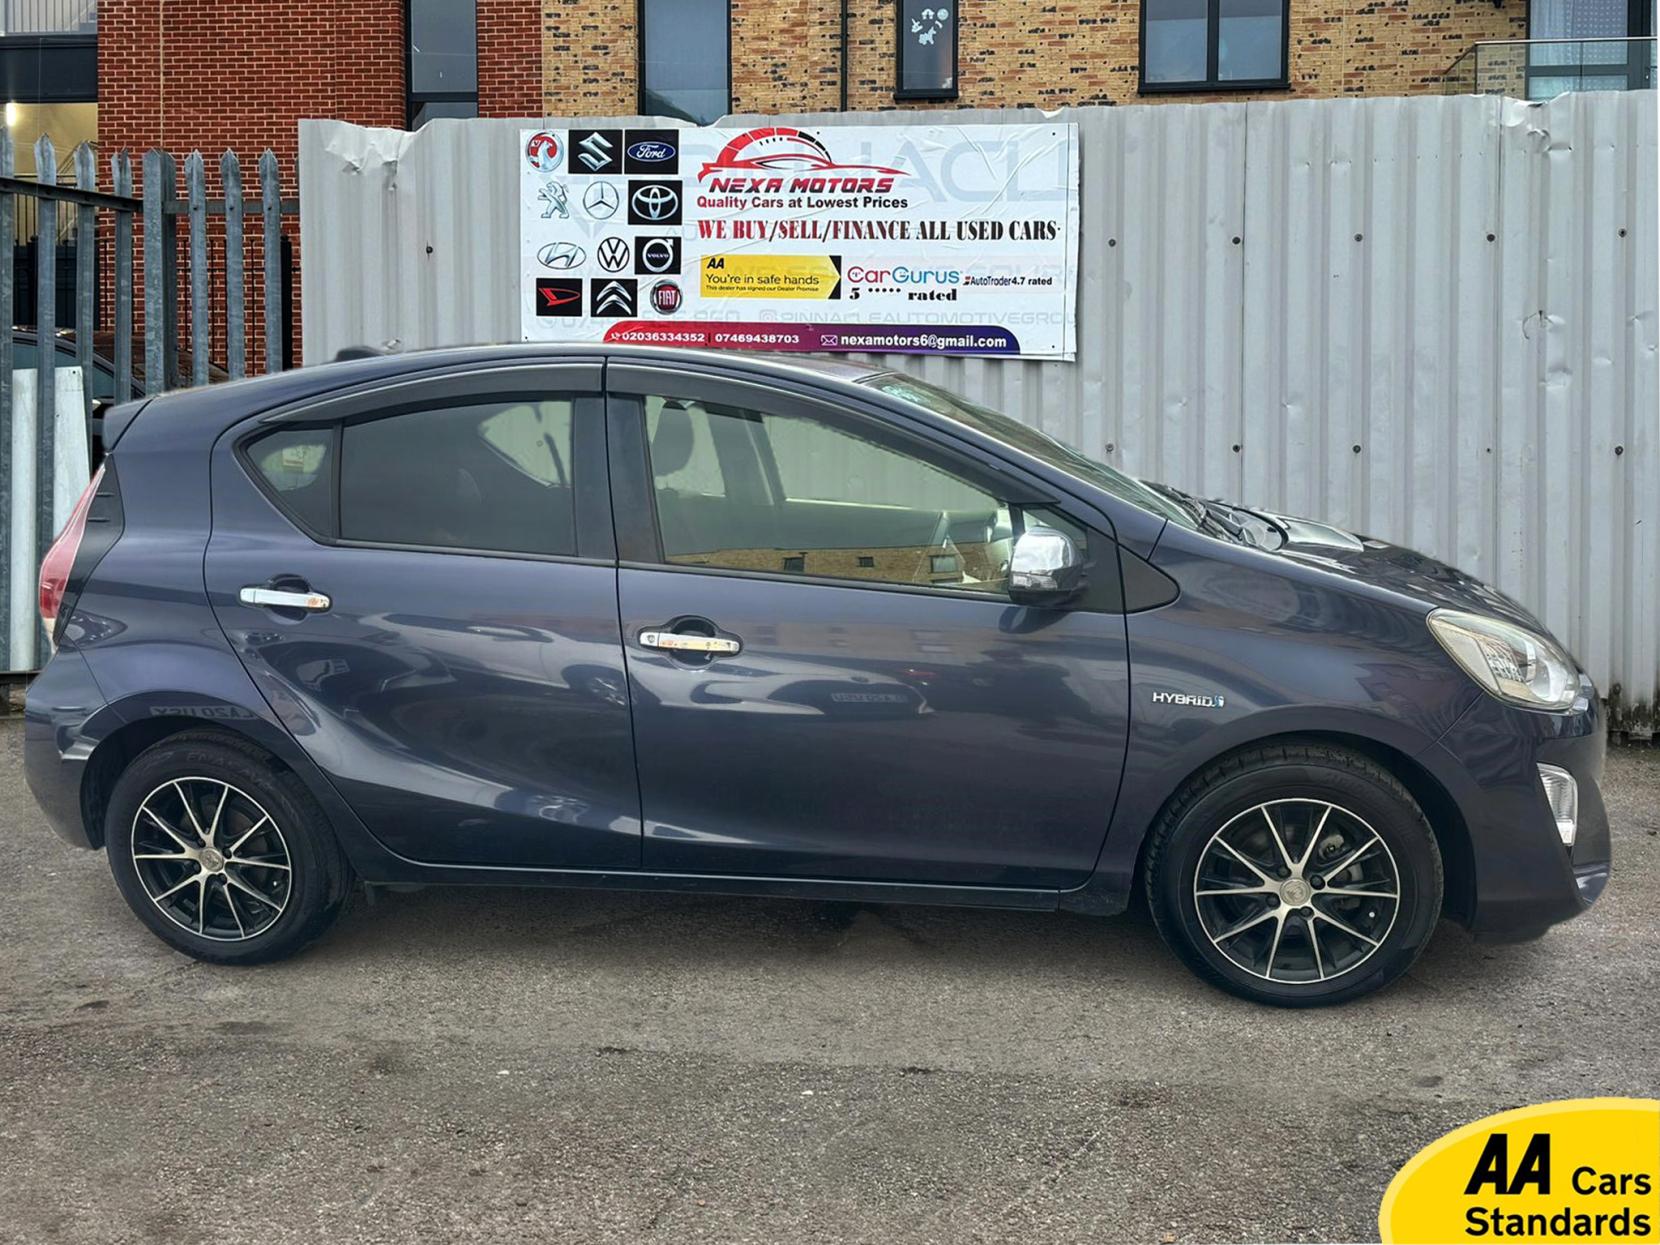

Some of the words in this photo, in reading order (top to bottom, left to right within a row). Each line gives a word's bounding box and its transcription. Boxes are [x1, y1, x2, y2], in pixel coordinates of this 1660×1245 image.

[636, 145, 666, 159] Ford
[709, 178, 784, 194] NEXA
[789, 178, 894, 194] MOTORS
[697, 196, 746, 211] Quality
[752, 196, 784, 209] Cars
[788, 197, 803, 209] at
[807, 196, 859, 209] Lowest
[863, 196, 908, 209] Prices
[697, 219, 727, 240] WE
[733, 219, 911, 243] BUY/SELL/FINANCE
[916, 220, 951, 241] ALL
[956, 220, 1004, 241] USED
[1009, 220, 1057, 241] CARS
[706, 257, 725, 270] AA
[705, 273, 741, 285] You're
[744, 273, 754, 284] in
[757, 273, 781, 285] safe
[784, 274, 820, 286] hands
[847, 266, 960, 284] CarGurus
[1011, 276, 1026, 286] 4.7
[1028, 276, 1053, 286] rated
[657, 289, 676, 305] FIAT
[849, 287, 861, 300] 5
[907, 288, 958, 301] rated
[622, 332, 705, 343] 02036334352
[715, 333, 800, 344] 07469438703
[841, 334, 1007, 350] nexamotors6@gmail.com
[1152, 692, 1213, 708] HYBRID
